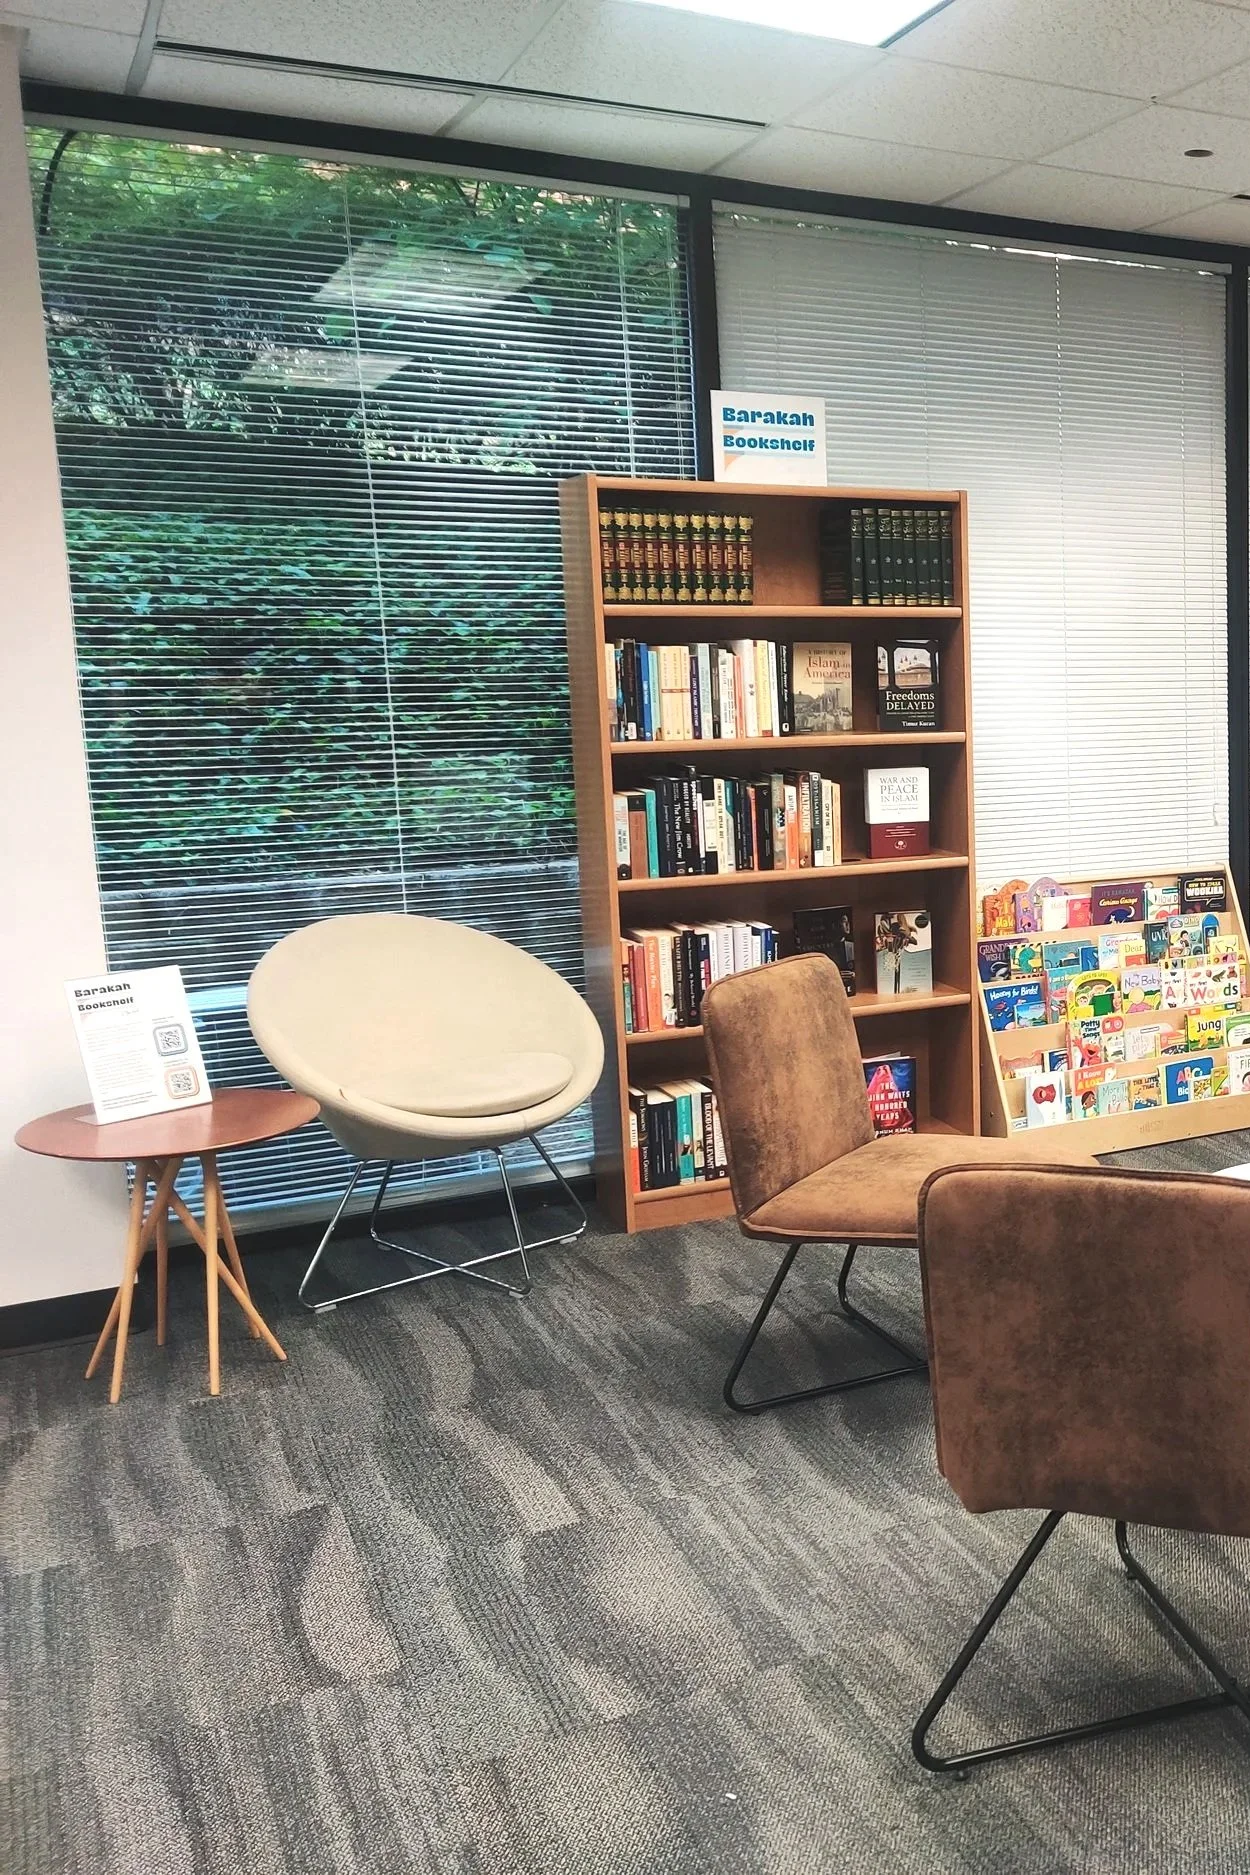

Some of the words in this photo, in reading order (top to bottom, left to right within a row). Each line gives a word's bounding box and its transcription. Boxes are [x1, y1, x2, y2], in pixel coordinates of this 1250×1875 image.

[722, 407, 815, 427] Barakah
[723, 435, 815, 451] Bookshelf
[808, 656, 840, 668] Islam
[804, 668, 850, 679] America
[886, 690, 935, 701] Freedoms
[886, 701, 935, 711] DELAYED
[880, 776, 899, 784] WAR
[880, 784, 919, 795] PEACE
[892, 794, 919, 802] ISLAM
[1124, 943, 1143, 954] Dear
[1124, 978, 1140, 988] New
[1141, 975, 1161, 987] Baby
[74, 982, 132, 998] Barakah
[990, 989, 1011, 1000] Hooray
[1012, 988, 1020, 998] for
[1021, 986, 1039, 995] Birds!
[77, 996, 135, 1012] Bookshelf
[1081, 1020, 1100, 1028] Potty
[881, 1082, 897, 1090] THE
[868, 1093, 885, 1102] JINN
[887, 1091, 911, 1100] WAITS
[875, 1101, 908, 1111] HUNDRED
[876, 1112, 900, 1120] YEARS
[706, 1146, 714, 1169] LEVANT
